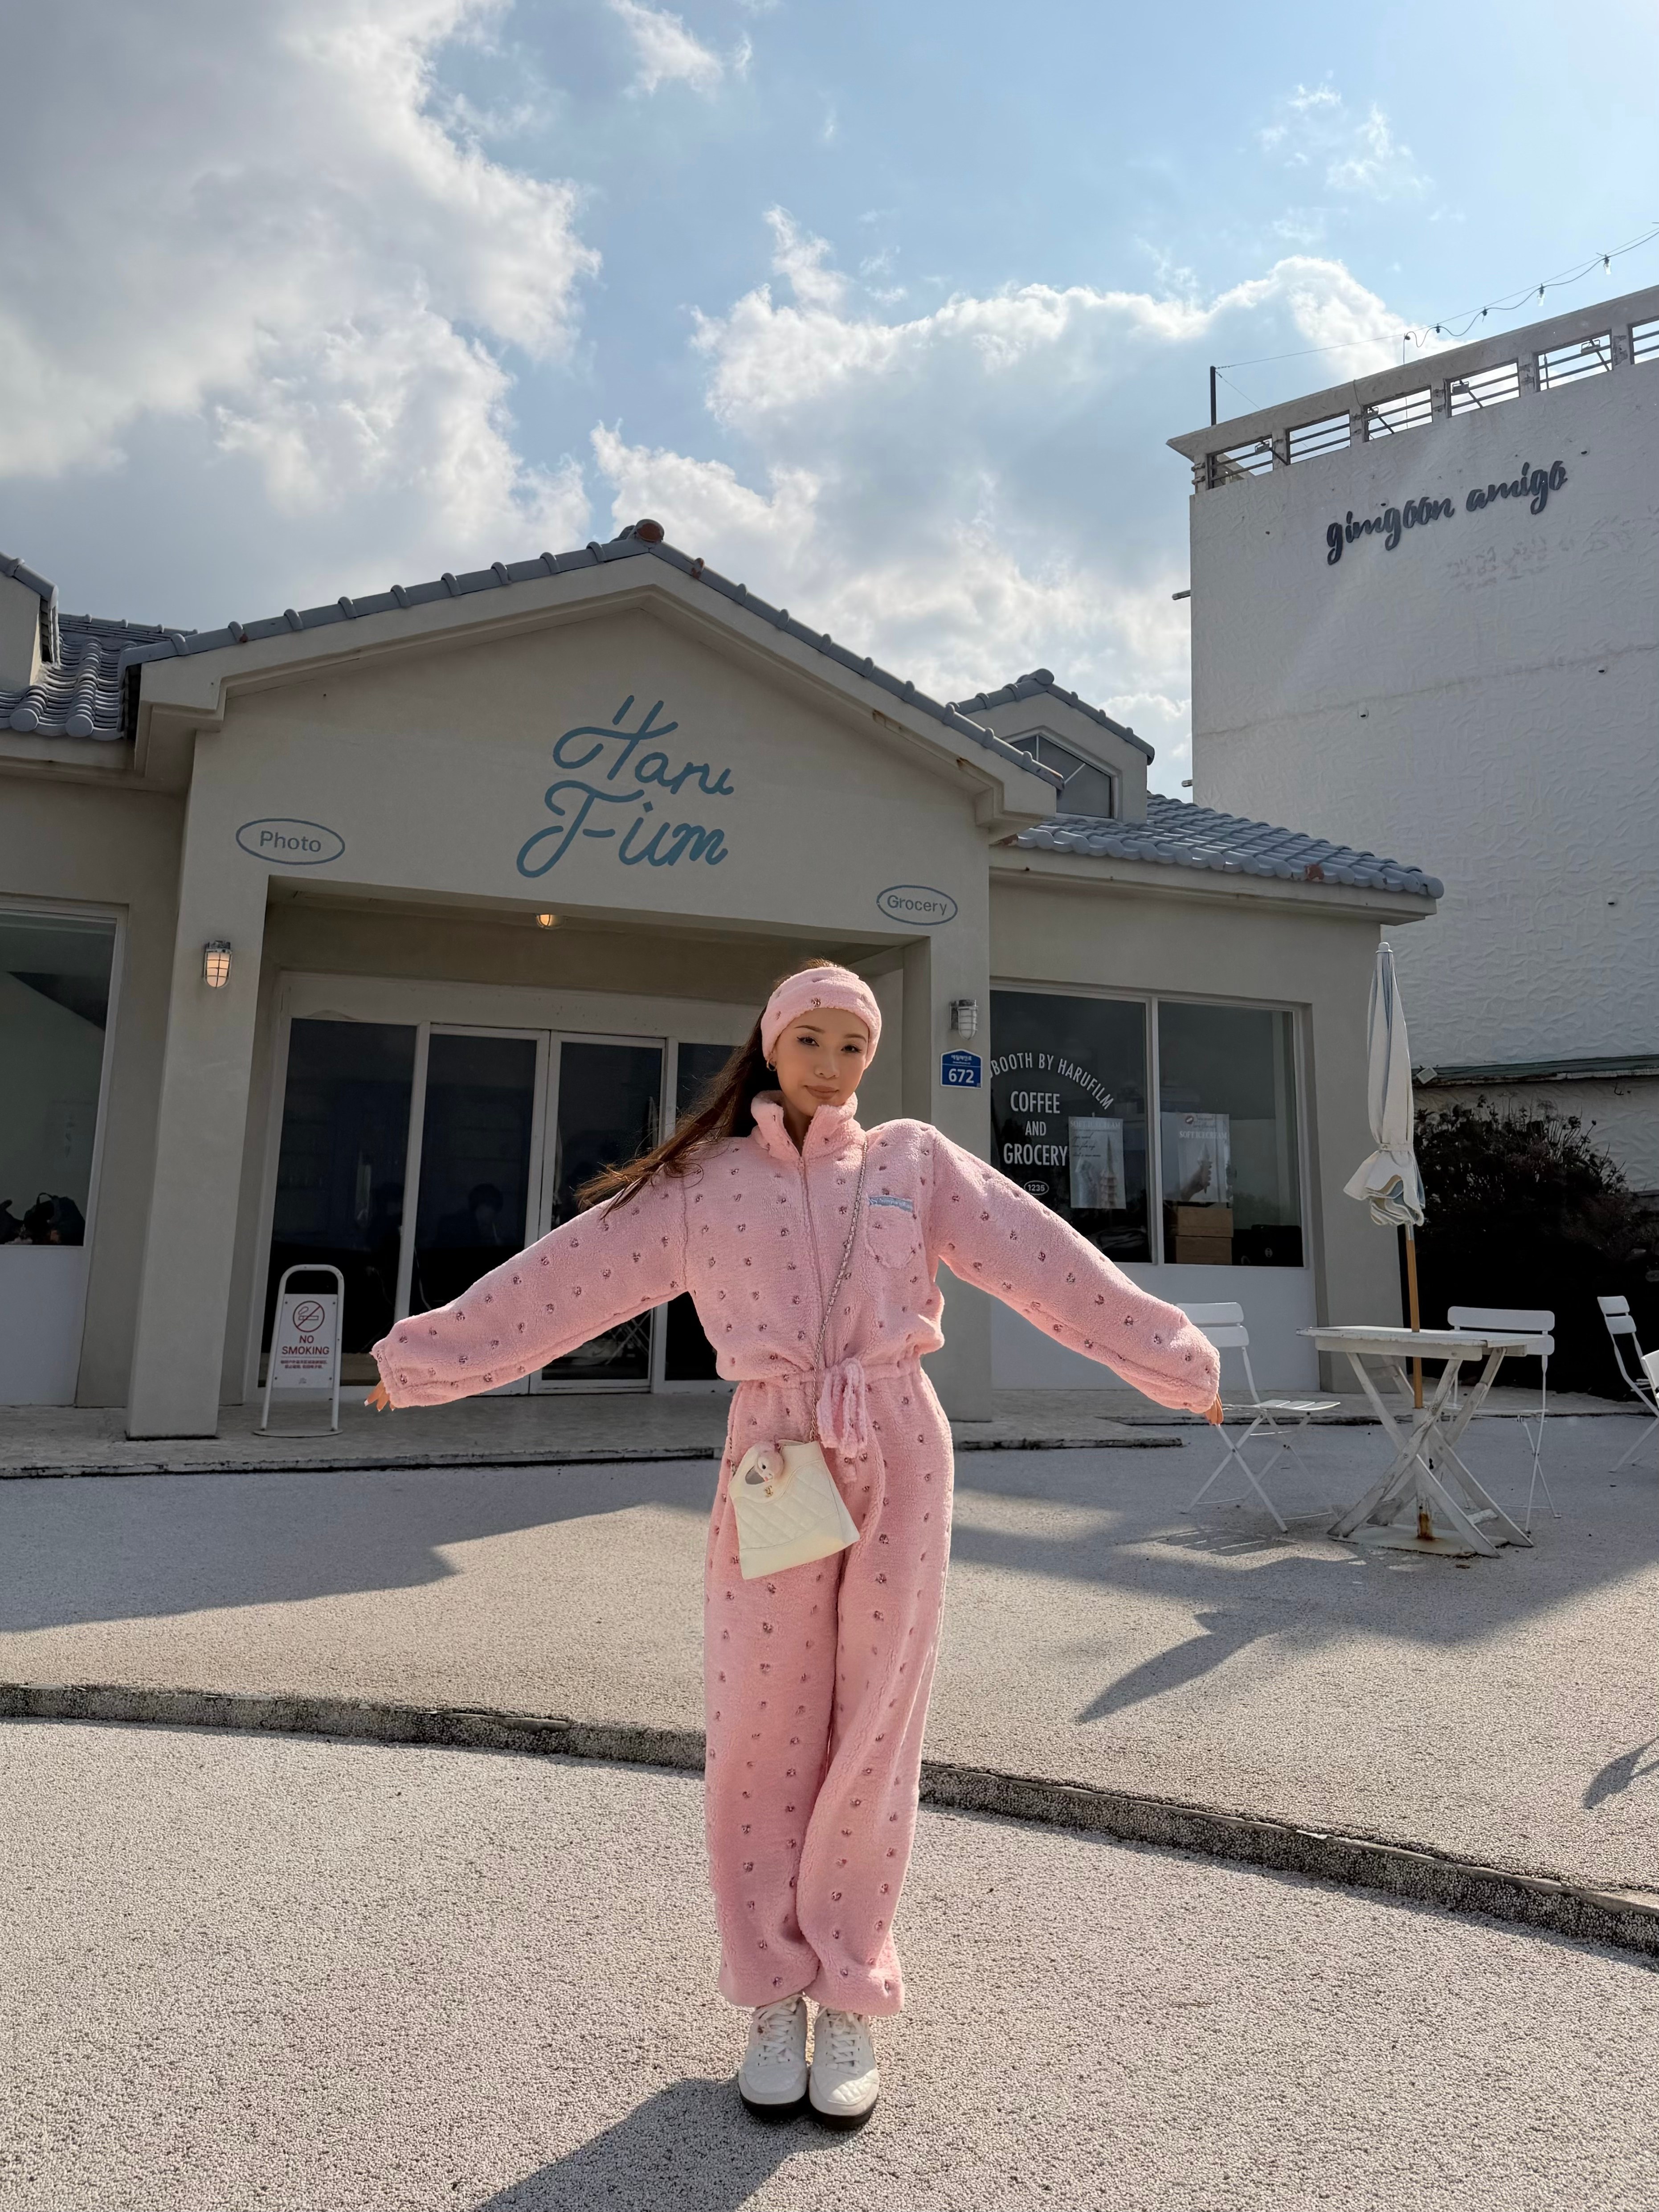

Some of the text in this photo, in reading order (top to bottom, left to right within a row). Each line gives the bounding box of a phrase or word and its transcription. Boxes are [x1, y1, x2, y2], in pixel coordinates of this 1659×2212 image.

[1327, 497, 1454, 565] gimgoon
[1466, 461, 1568, 515] amigo
[553, 695, 734, 795] Haru
[260, 830, 322, 852] Photo
[887, 895, 947, 916] Grocery
[948, 1068, 974, 1083] 672
[990, 1052, 1114, 1110] BOOTH BY HARUFILM
[1010, 1091, 1060, 1114] COFFEE
[1025, 1120, 1046, 1136] AND
[1003, 1142, 1068, 1166] GROCERY
[282, 1346, 330, 1355] SMOKING
[299, 1335, 314, 1344] NO
